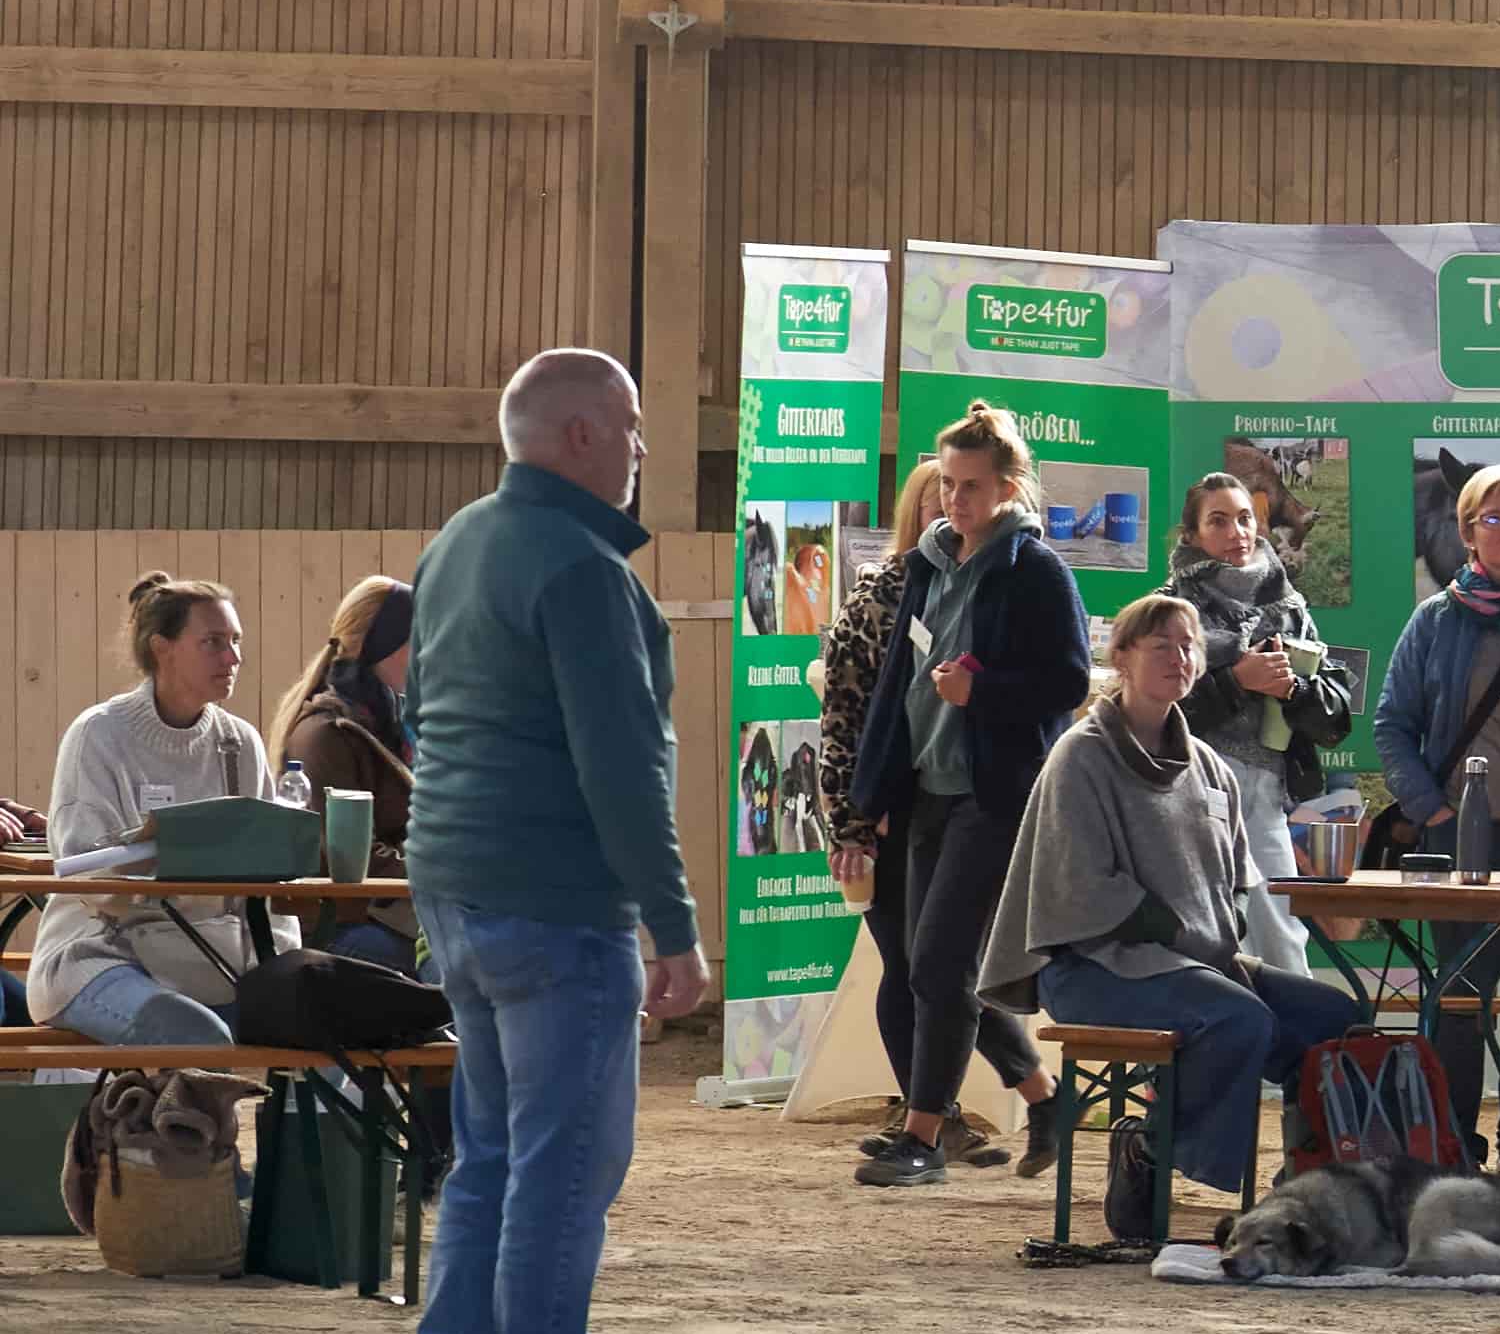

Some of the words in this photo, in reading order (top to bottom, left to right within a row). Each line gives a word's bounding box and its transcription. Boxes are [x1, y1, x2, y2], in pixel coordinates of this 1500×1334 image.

[1016, 338, 1039, 349] THAN
[1039, 340, 1060, 351] JUST
[1061, 342, 1080, 352] TAPE
